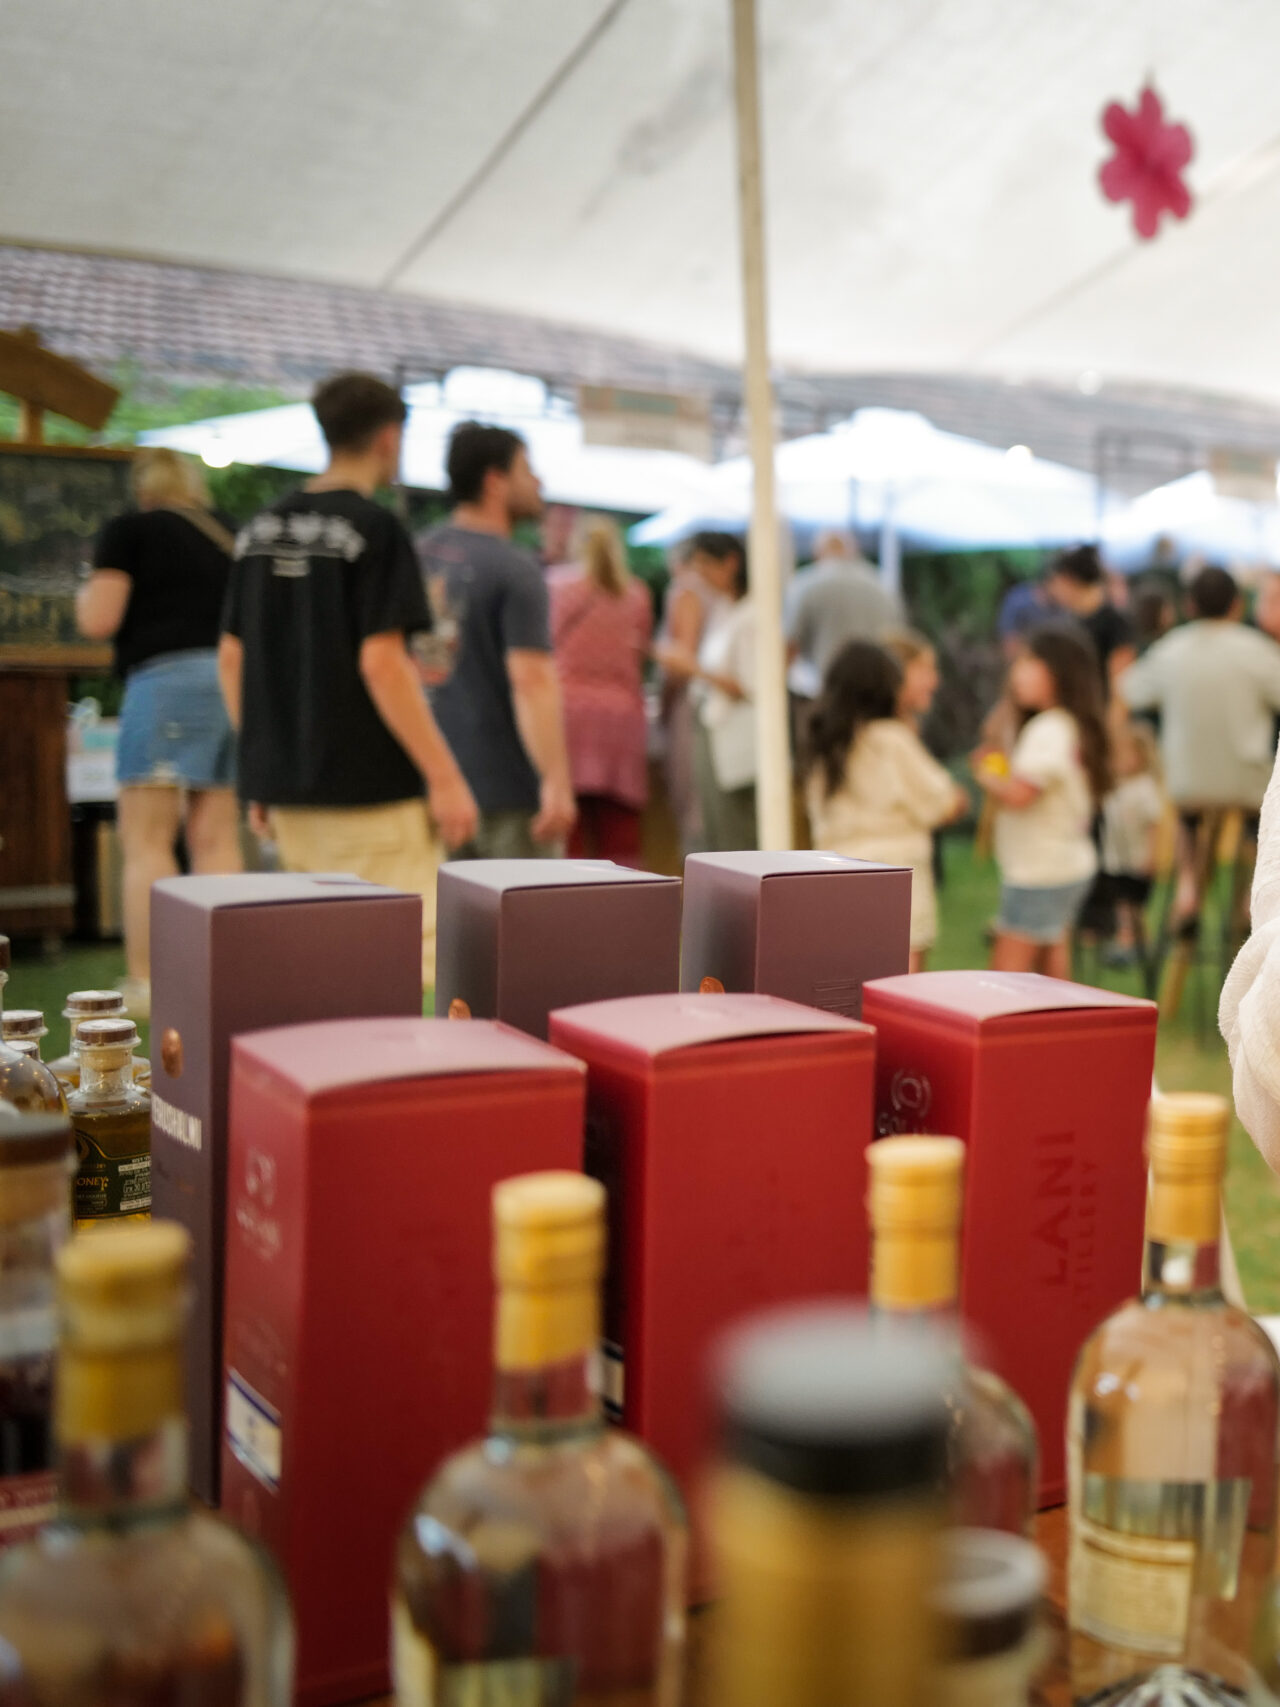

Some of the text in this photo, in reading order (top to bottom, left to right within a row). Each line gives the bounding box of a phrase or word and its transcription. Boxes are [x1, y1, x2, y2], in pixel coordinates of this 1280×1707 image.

[76, 1176, 108, 1192] ONEY
[1034, 1132, 1073, 1288] LANI
[1071, 1158, 1099, 1314] TILLERY
